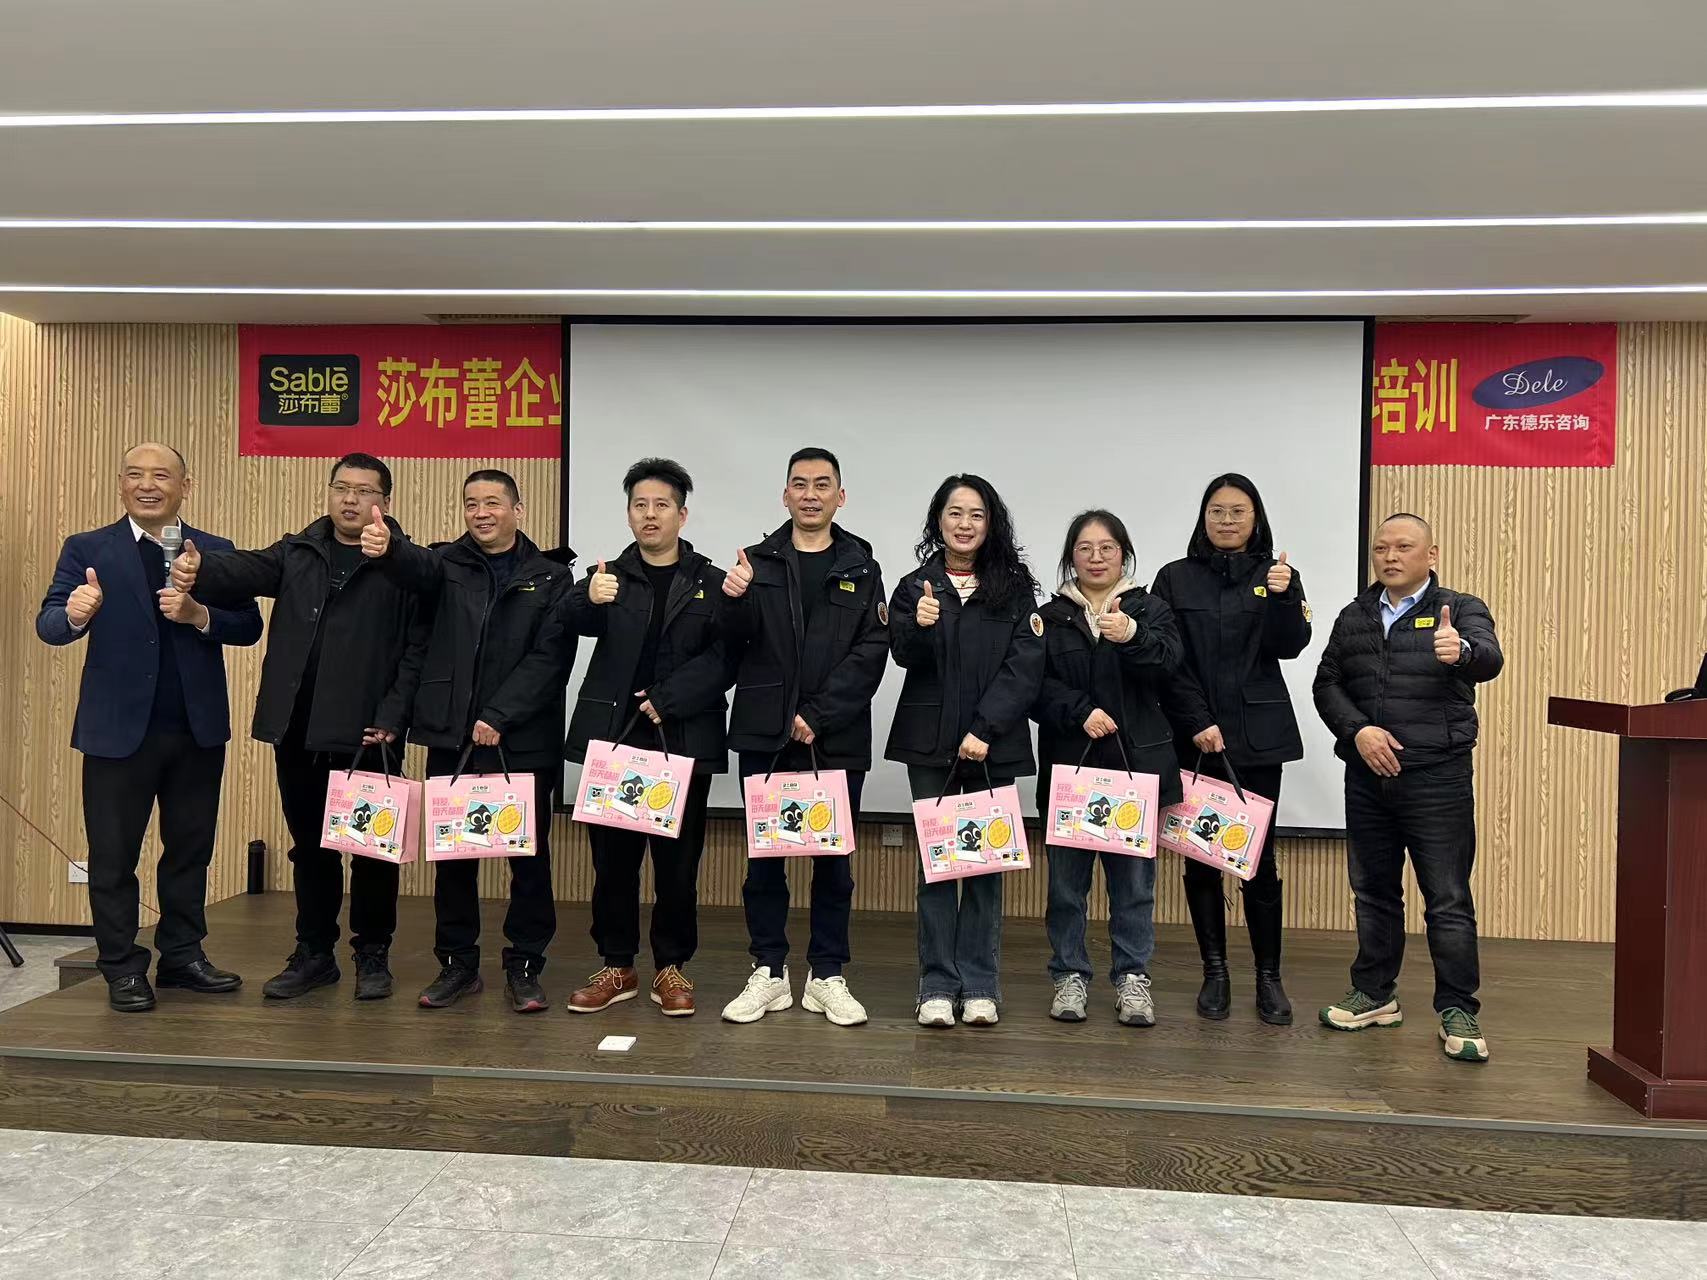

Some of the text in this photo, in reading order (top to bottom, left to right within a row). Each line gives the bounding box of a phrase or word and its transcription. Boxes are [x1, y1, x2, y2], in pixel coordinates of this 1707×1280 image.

[1372, 357, 1458, 434] 培训
[1502, 368, 1569, 396] Dele
[1484, 413, 1590, 431] 广东德乐咨询
